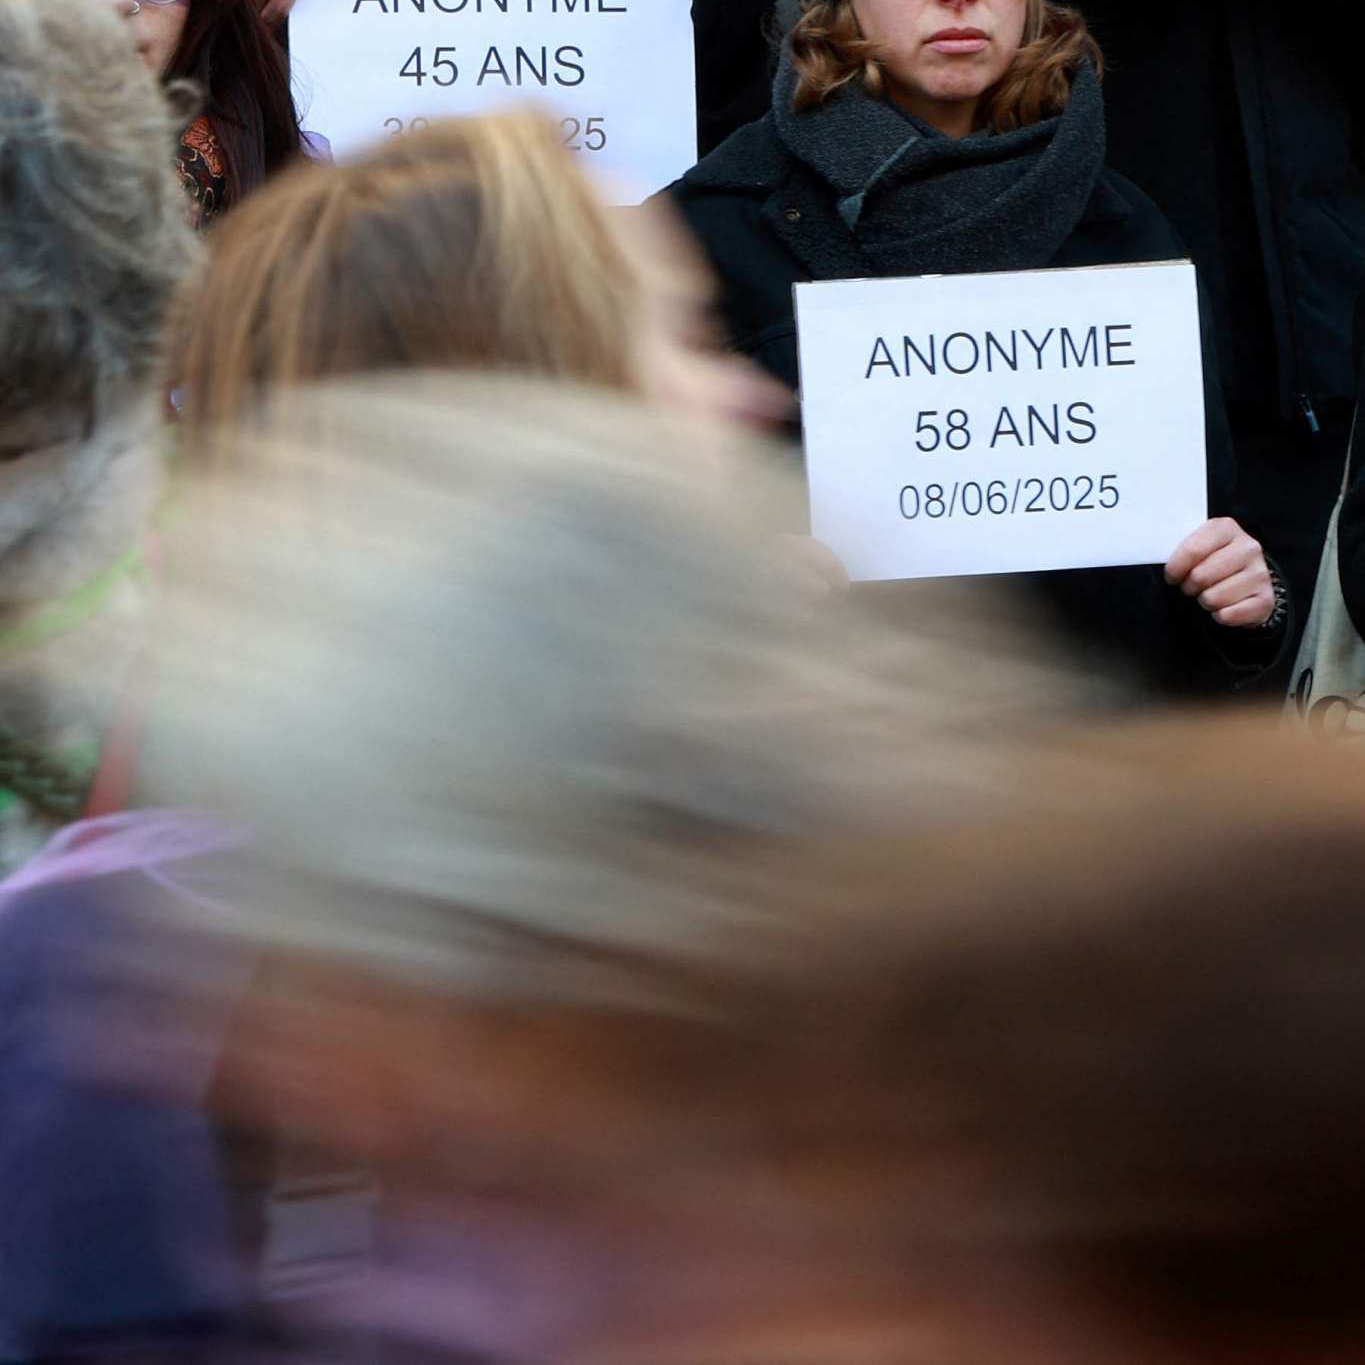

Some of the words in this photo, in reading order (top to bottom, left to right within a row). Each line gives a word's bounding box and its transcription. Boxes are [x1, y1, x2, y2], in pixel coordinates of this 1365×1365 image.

[399, 46, 458, 87] 45
[476, 46, 585, 87] ANS
[864, 324, 1136, 379] ANONYME
[915, 409, 971, 452] 58
[989, 402, 1096, 448] ANS
[899, 474, 1119, 520] 08/06/2025
